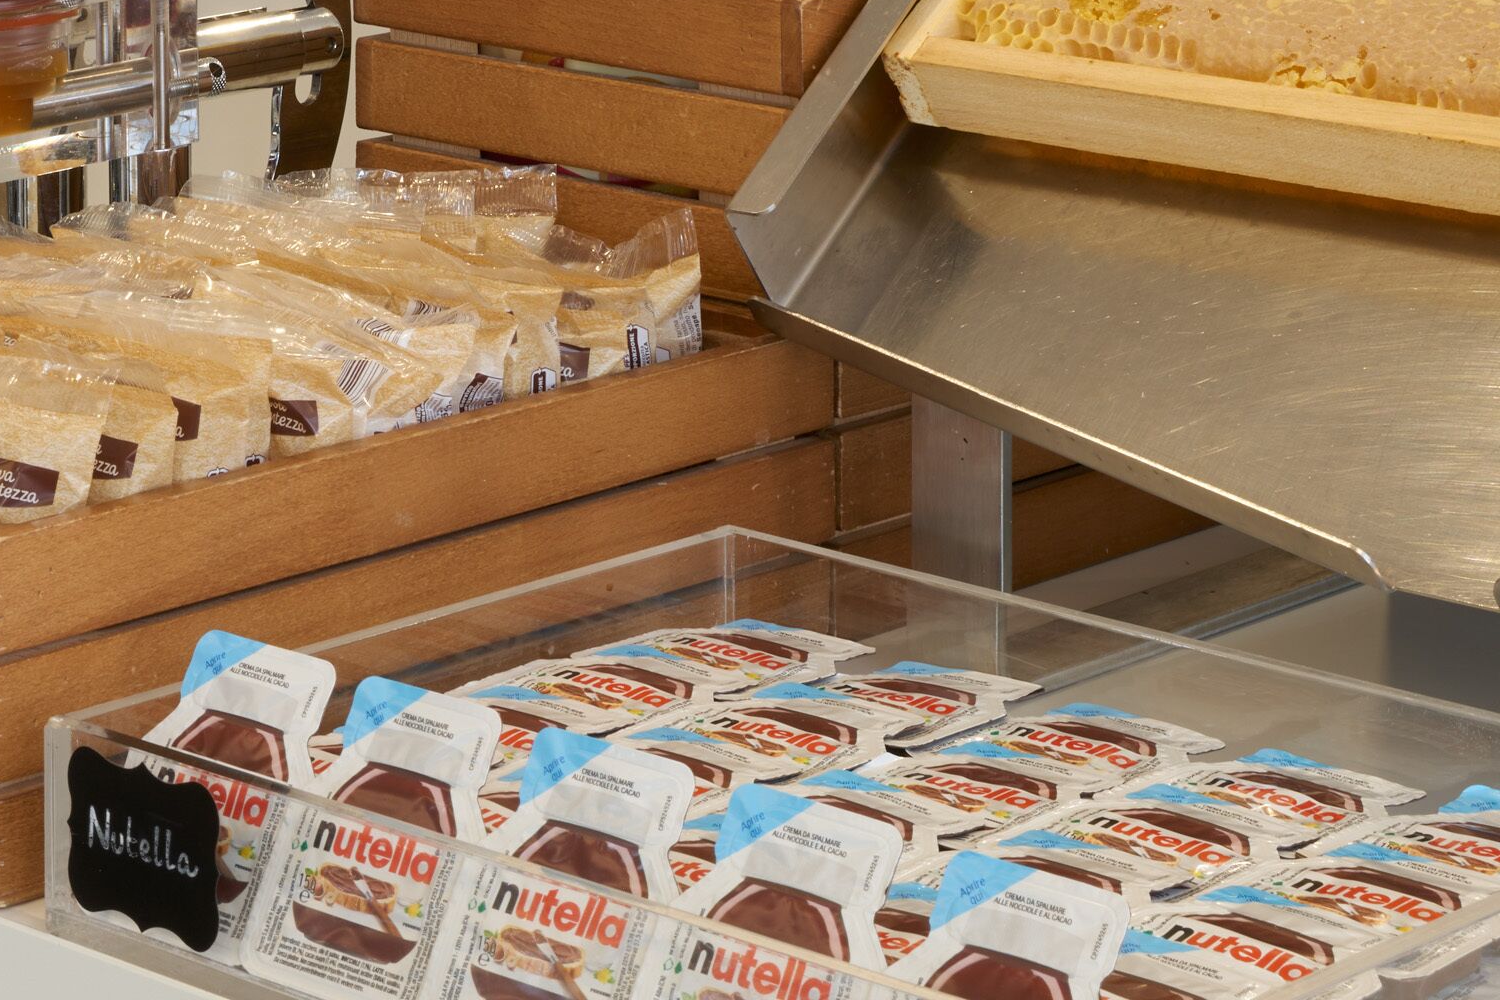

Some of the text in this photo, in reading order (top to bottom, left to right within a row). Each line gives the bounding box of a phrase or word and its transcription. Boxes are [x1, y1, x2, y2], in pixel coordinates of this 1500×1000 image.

[204, 651, 226, 671] Aprire
[671, 636, 789, 671] nutella
[212, 663, 223, 676] qui
[230, 667, 241, 675] ALLE
[240, 669, 263, 682] NOCCIOLE
[266, 676, 273, 684] AL
[273, 678, 290, 689] CACAO
[238, 662, 286, 680] CREMA DA SPALMARE
[553, 669, 673, 708] nutella
[832, 684, 956, 716] nutella
[365, 701, 388, 721] Aprire
[373, 714, 385, 727] qui
[401, 712, 449, 730] CREMA DA SPALMARE
[393, 718, 405, 726] ALLE
[405, 720, 427, 733] NOCCIOLE
[430, 727, 437, 735] AL
[437, 728, 454, 740] CACAO
[711, 716, 838, 755] nutella
[1007, 726, 1139, 770] nutella
[543, 755, 565, 776] Aprire
[551, 769, 563, 782] qui
[581, 768, 635, 788] CREMA DA SPALMARE
[571, 773, 585, 782] ALLE
[585, 776, 610, 790] NOCCIOLE
[613, 783, 620, 793] AL
[621, 786, 641, 799] CACAO
[903, 772, 1039, 810] nutella
[1206, 777, 1347, 824] nutella
[740, 811, 766, 832] Aprire
[750, 826, 763, 840] qui
[88, 805, 199, 878] Nutella
[772, 830, 786, 840] ALLE
[786, 833, 814, 849] NOCCIOLE
[818, 843, 827, 853] AL
[827, 844, 848, 858] CACAO
[782, 825, 842, 849] CREMA DA SPALMARE
[1088, 816, 1235, 865] nutella
[1404, 831, 1500, 862] nute
[313, 820, 440, 886] nutella
[959, 877, 986, 898] Aprire
[969, 891, 984, 905] qui
[1292, 876, 1445, 922] nutella
[491, 881, 628, 949] nutella
[993, 896, 1008, 907] ALLE
[1009, 900, 1038, 916] NOCCIOLE
[1043, 910, 1052, 920] AL
[1052, 912, 1073, 926] CACAO
[1004, 891, 1066, 915] CREMA DA SPALMARE
[1164, 922, 1315, 982] nutella
[687, 939, 832, 1000] nutella
